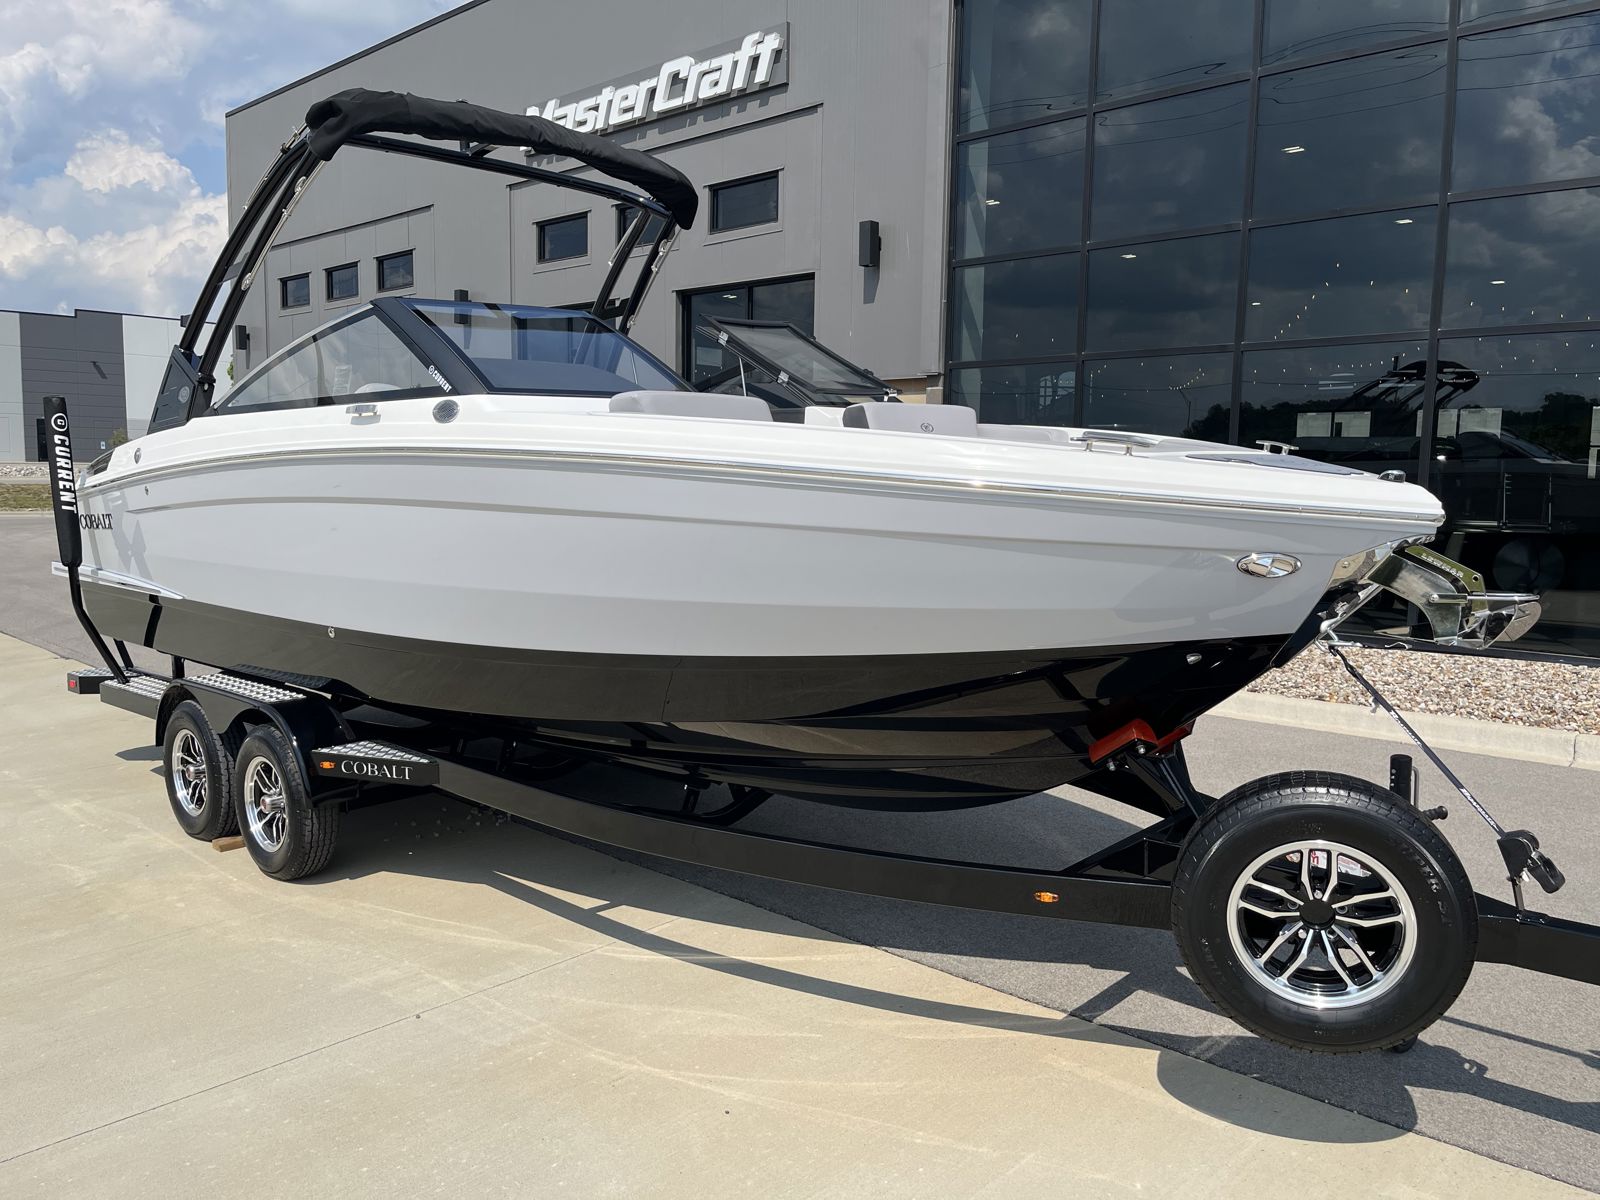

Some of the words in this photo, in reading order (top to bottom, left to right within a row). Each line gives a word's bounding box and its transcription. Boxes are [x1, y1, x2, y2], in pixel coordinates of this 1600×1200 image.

[53, 434, 77, 514] CURRENT
[79, 513, 113, 529] COBALT
[341, 760, 414, 780] COBALT
